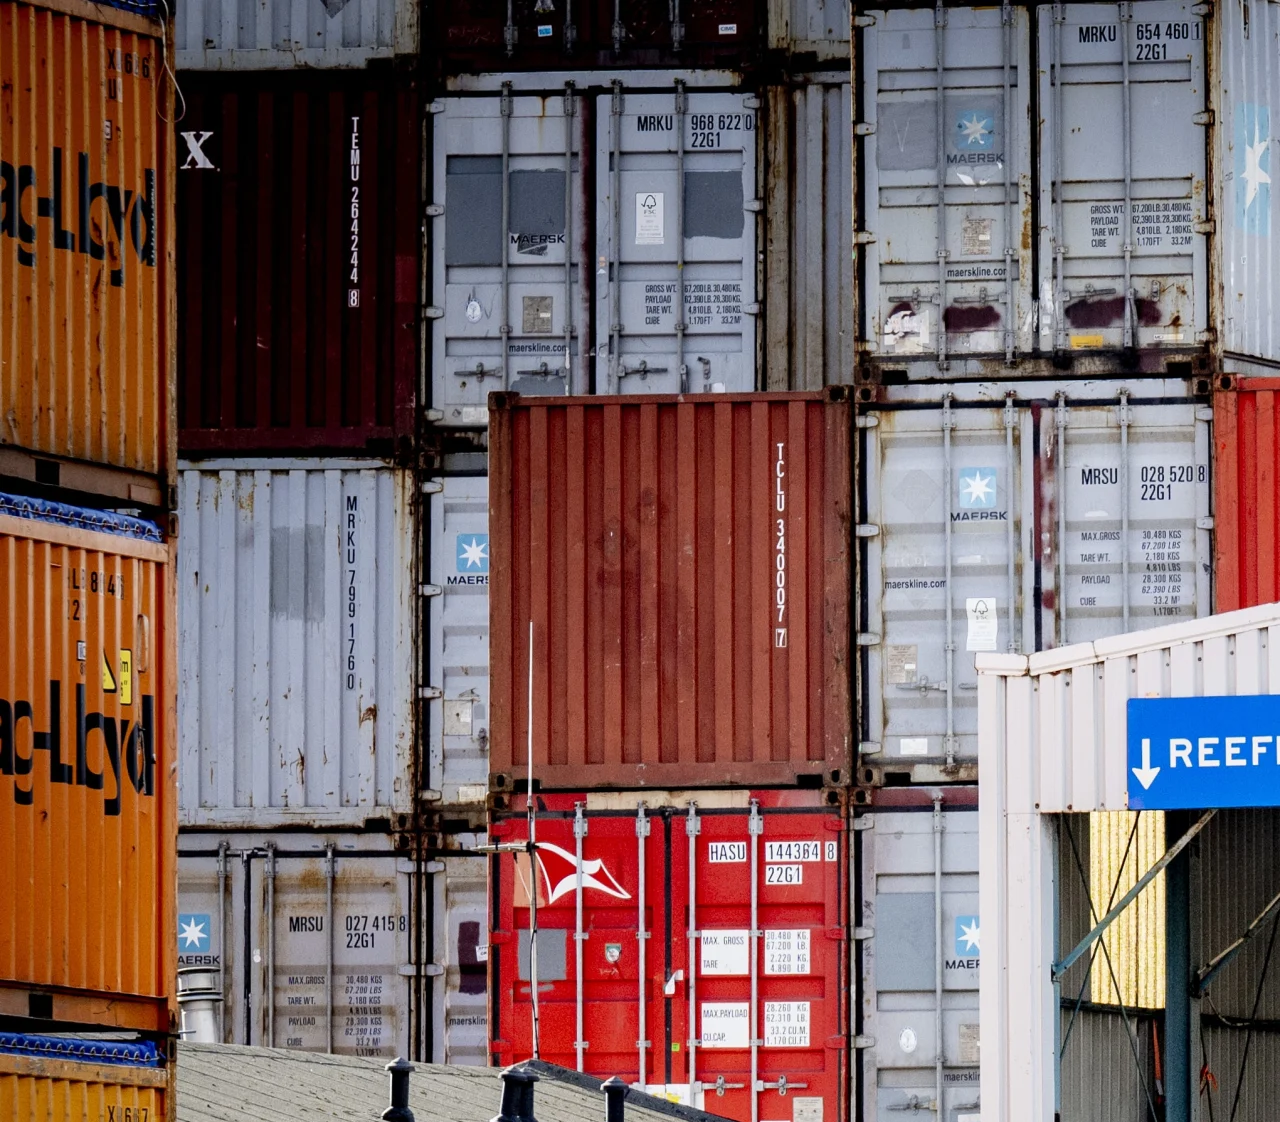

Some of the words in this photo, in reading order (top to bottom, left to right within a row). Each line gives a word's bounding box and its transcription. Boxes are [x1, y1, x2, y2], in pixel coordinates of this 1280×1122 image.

[1078, 25, 1118, 44] MRKU
[1136, 22, 1161, 41] 654
[1165, 22, 1190, 41] 460
[1136, 44, 1168, 61] 22G1
[636, 115, 673, 132] MRKU
[690, 114, 715, 131] 968
[717, 114, 742, 131] 622
[690, 132, 721, 148] 22G1
[350, 116, 361, 181] TEMU
[946, 153, 1006, 165] MAERSK
[1090, 204, 1110, 215] GROSS
[1090, 215, 1119, 226] PAYLOAD
[350, 186, 360, 284] 264244
[1091, 226, 1105, 237] TARE
[510, 233, 566, 245] MAERSK
[1091, 238, 1107, 249] CUBE
[645, 284, 664, 294] GROSS
[645, 294, 672, 304] PAYLOAD
[645, 305, 661, 315] TARE
[645, 315, 661, 325] CUBE
[776, 442, 785, 512] TCLU
[1081, 467, 1118, 485] MRSU
[1141, 466, 1165, 483] 028
[1169, 465, 1194, 483] 520
[1141, 484, 1172, 501] 22G1
[950, 511, 1008, 521] MAERSK
[346, 496, 358, 564] MRKU
[1080, 552, 1096, 562] TARE
[776, 519, 785, 623] 340007
[1081, 575, 1111, 585] PAYLOAD
[346, 569, 357, 618] 799
[1080, 596, 1096, 606] CUBE
[710, 843, 747, 862] HASU
[768, 842, 820, 860] 144364
[827, 842, 836, 860] 8
[767, 865, 802, 883] 22G1
[289, 916, 323, 932] MRSU
[345, 915, 368, 932] 027
[372, 915, 395, 932] 415
[346, 932, 375, 948] 22G1
[723, 936, 745, 946] GROSS
[702, 959, 718, 969] TARE
[287, 996, 302, 1005] TARE
[288, 1016, 316, 1026] PAYLOAD
